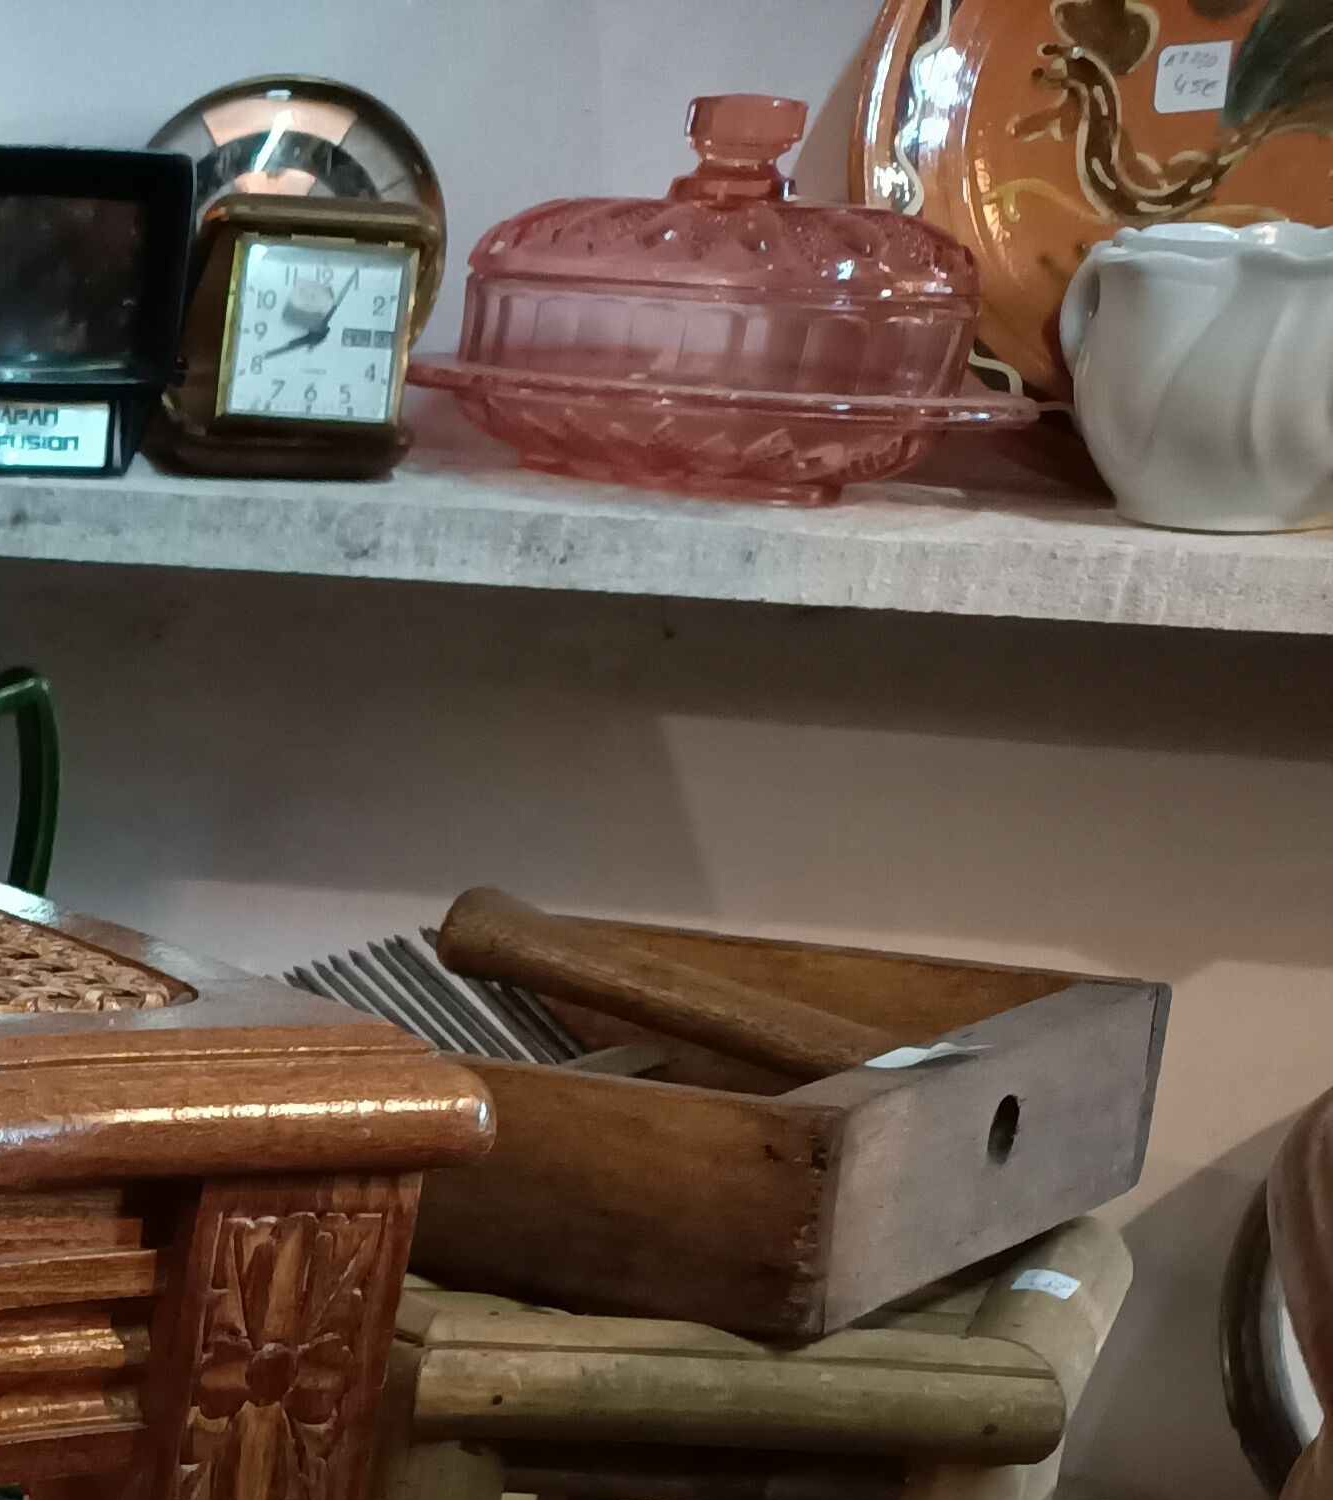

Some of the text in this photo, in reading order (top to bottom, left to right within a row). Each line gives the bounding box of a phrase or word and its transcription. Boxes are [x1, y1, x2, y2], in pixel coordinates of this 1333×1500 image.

[284, 265, 299, 286] 11
[256, 289, 278, 310] 10
[372, 296, 386, 317] 2
[254, 321, 269, 342] 9
[249, 355, 264, 376] 8
[364, 362, 376, 383] 4
[271, 379, 286, 400] 7
[303, 383, 318, 401] 6
[339, 384, 352, 404] 5
